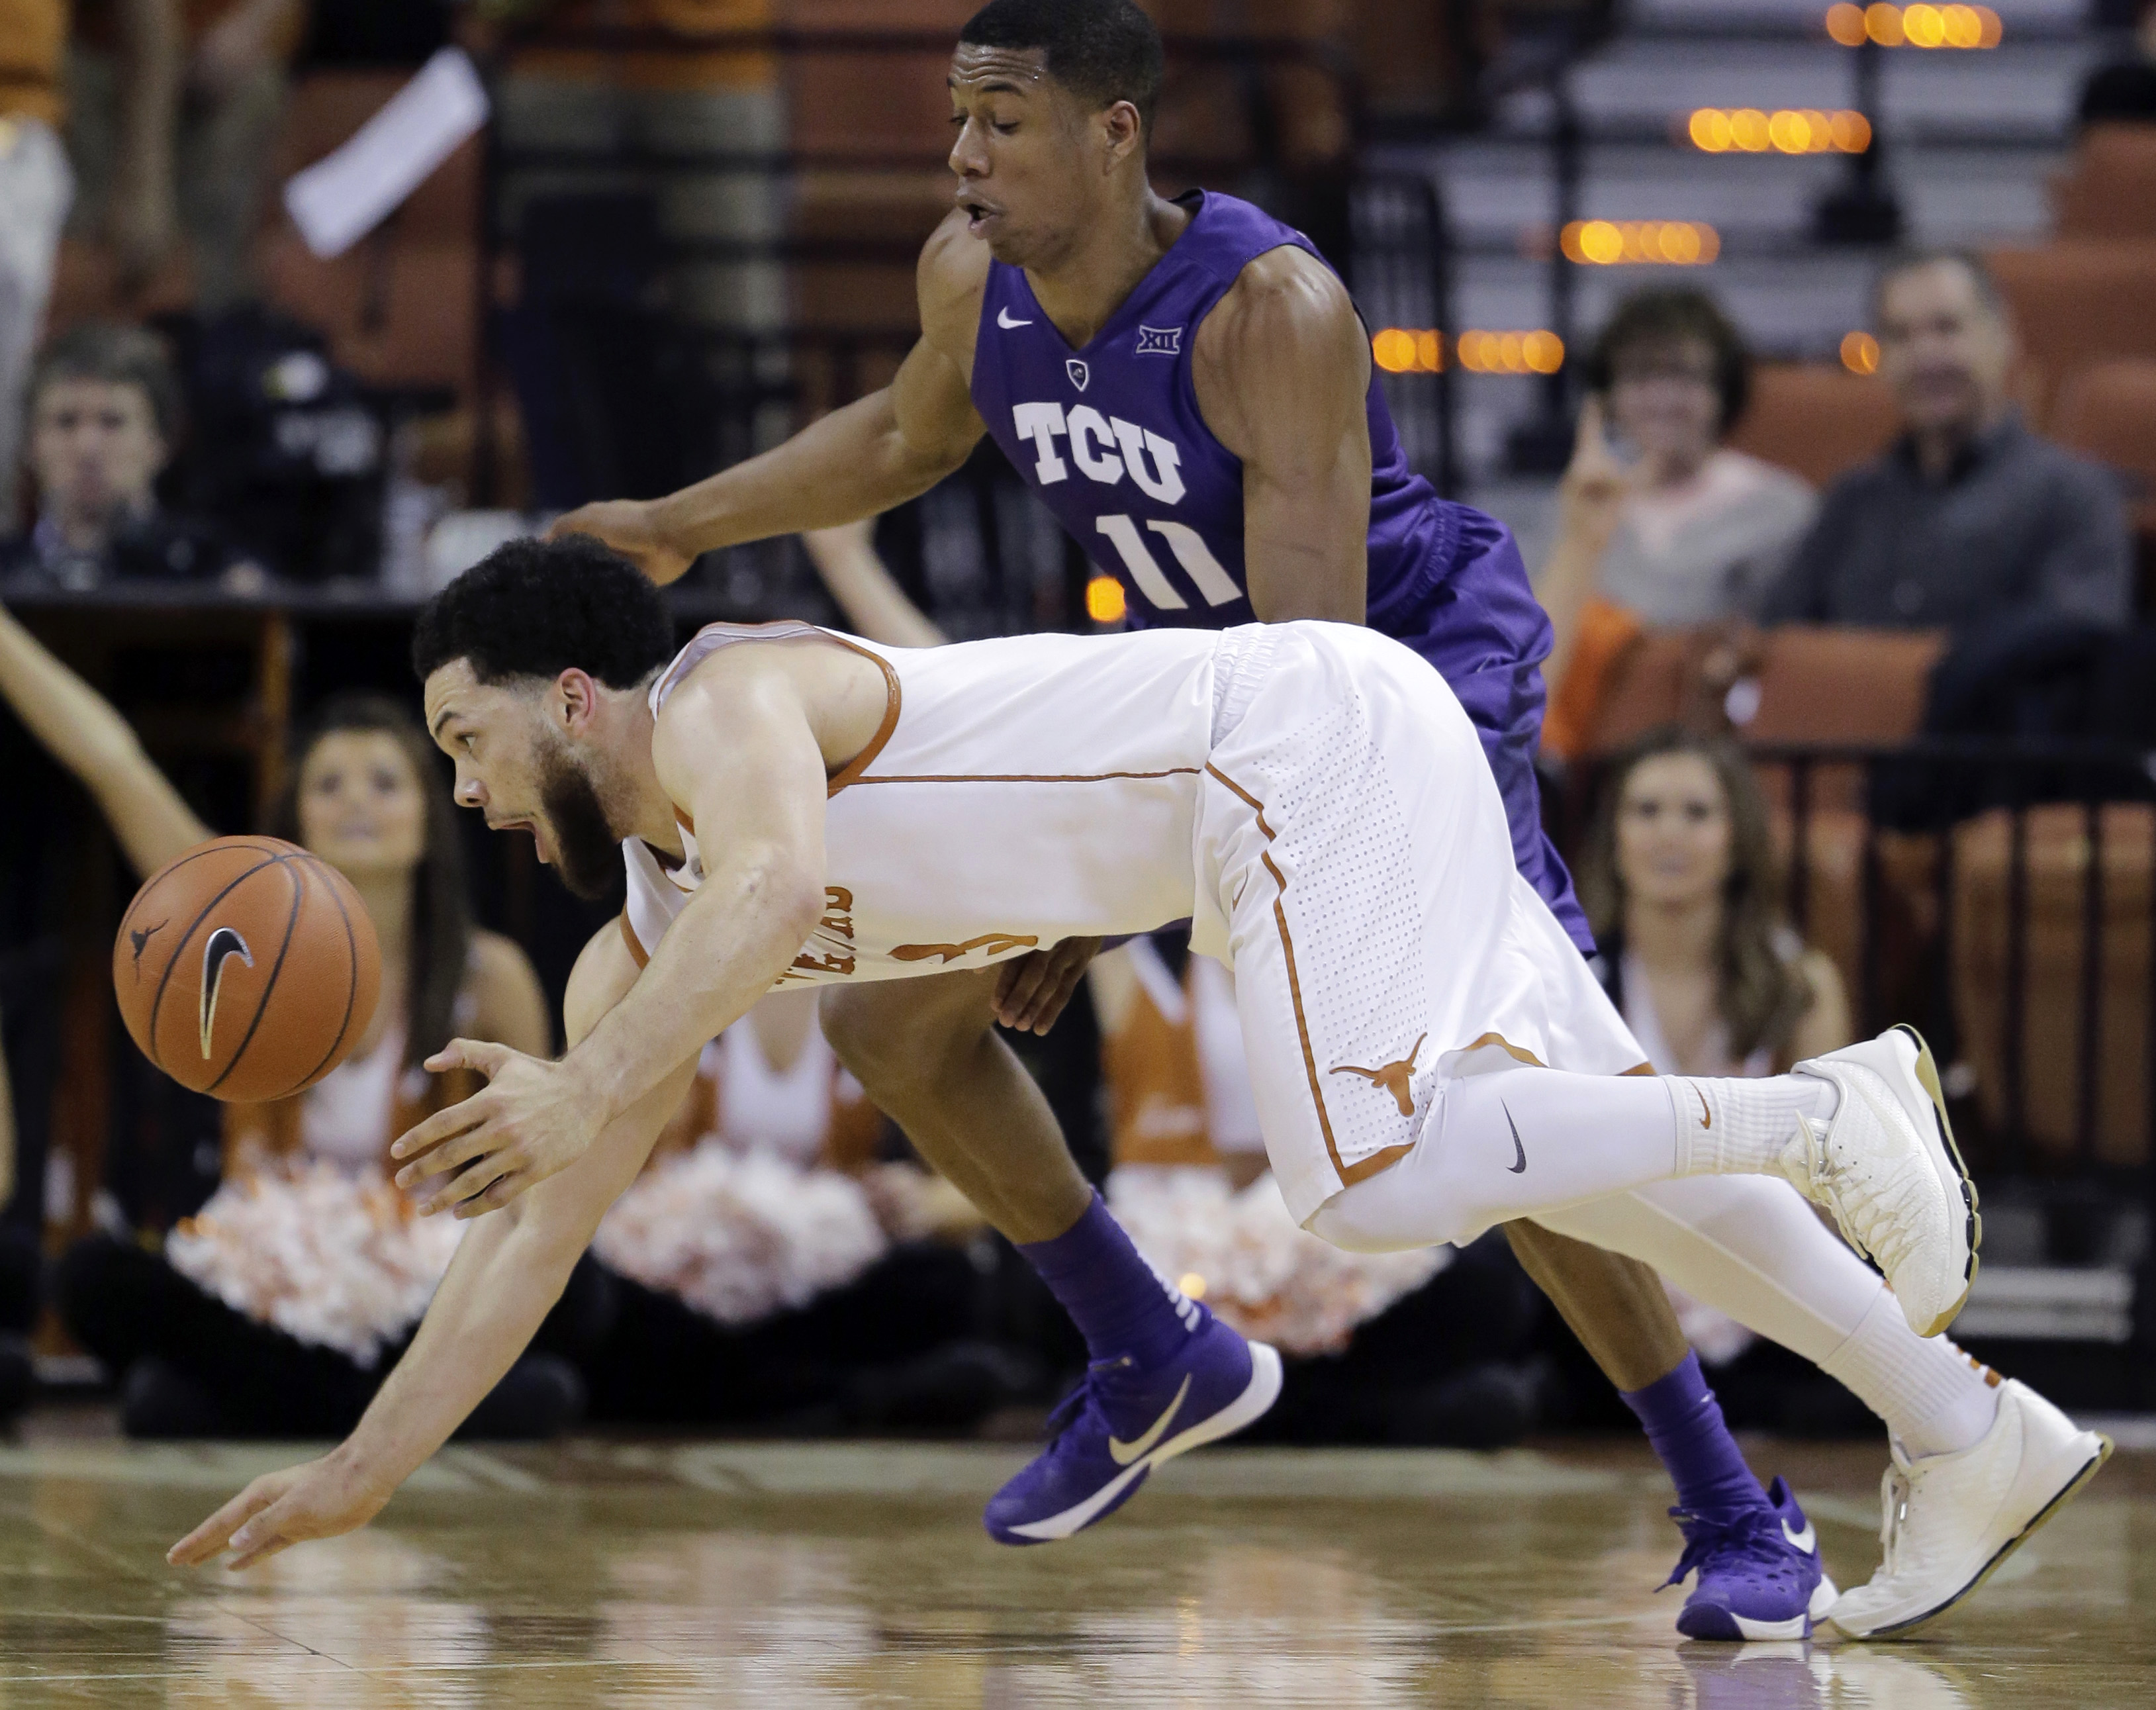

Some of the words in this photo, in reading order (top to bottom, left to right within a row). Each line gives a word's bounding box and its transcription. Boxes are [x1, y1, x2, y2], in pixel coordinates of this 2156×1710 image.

[1137, 325, 1182, 354] XII
[1012, 401, 1186, 505] TCU
[1096, 514, 1243, 610] 11
